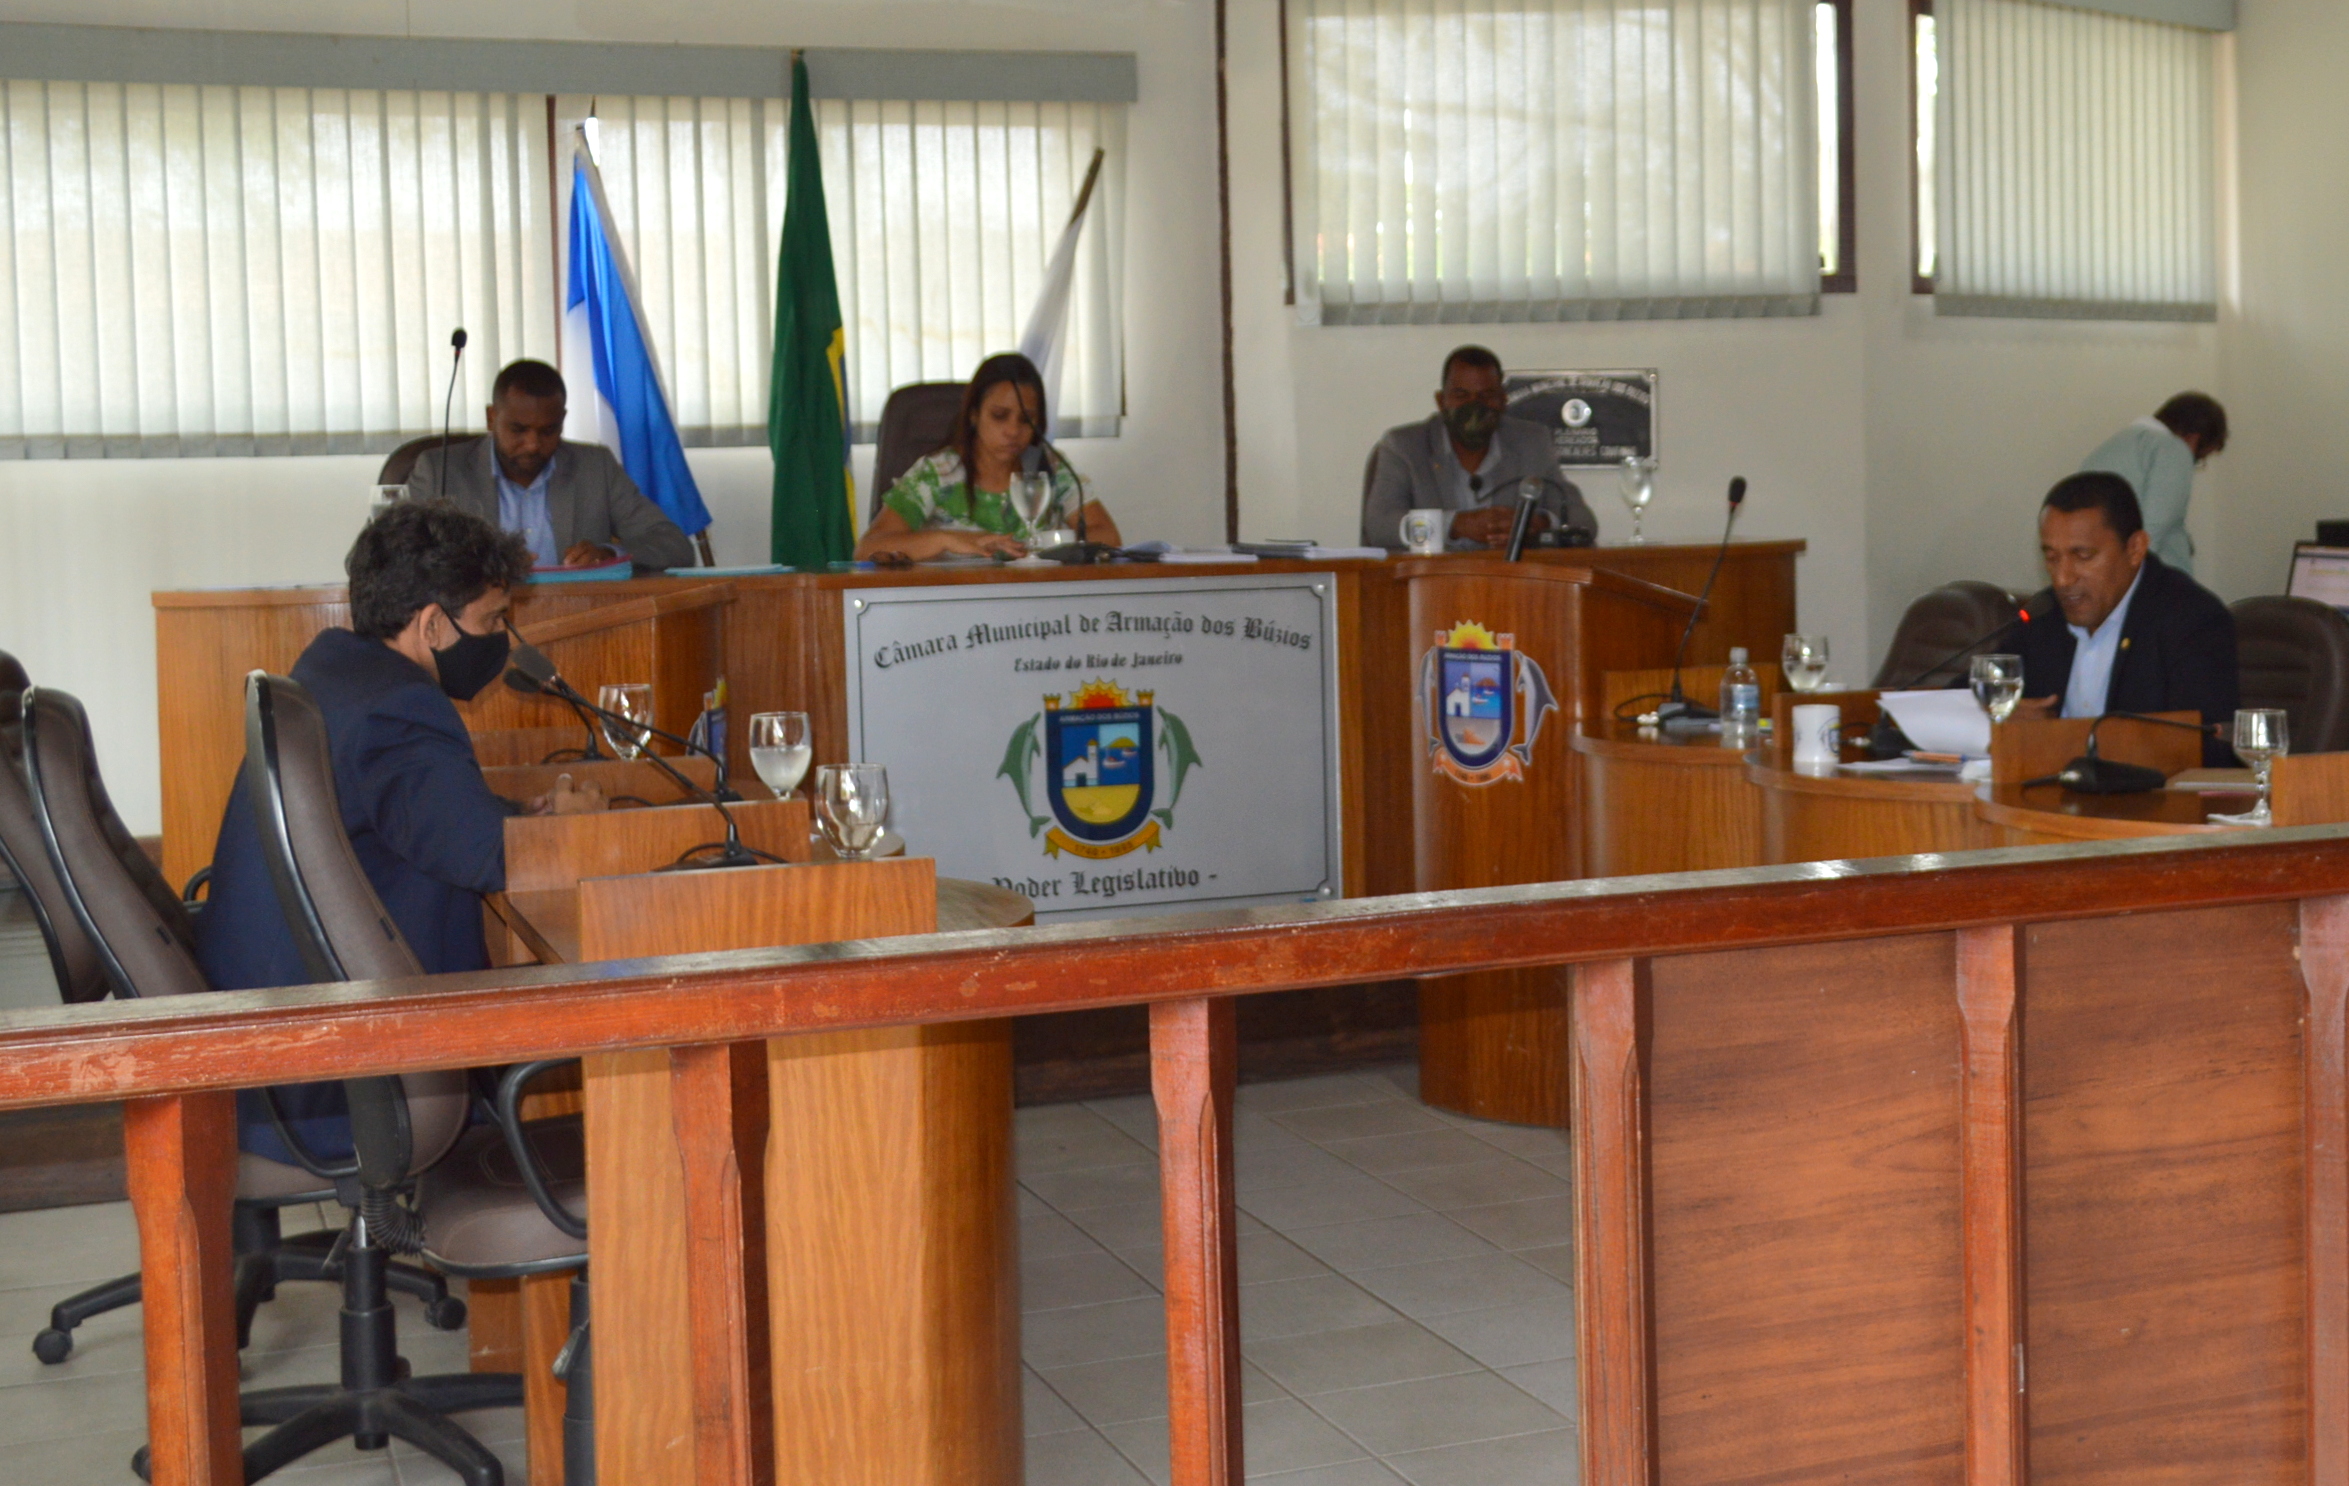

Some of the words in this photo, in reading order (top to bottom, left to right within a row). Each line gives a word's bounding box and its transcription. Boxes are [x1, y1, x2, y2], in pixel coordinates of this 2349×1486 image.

[874, 634, 958, 669] Câmara
[965, 614, 1071, 649] Municipal
[1079, 614, 1100, 634] de
[1106, 610, 1194, 639] Armação
[1201, 615, 1235, 636] dos
[1243, 617, 1313, 650] Búzios
[1014, 656, 1060, 672] Estado
[1065, 655, 1082, 669] do
[1086, 654, 1108, 668] Rio
[1111, 653, 1127, 667] de
[1131, 651, 1183, 668] Janeiro
[1071, 864, 1199, 897] Legislativo
